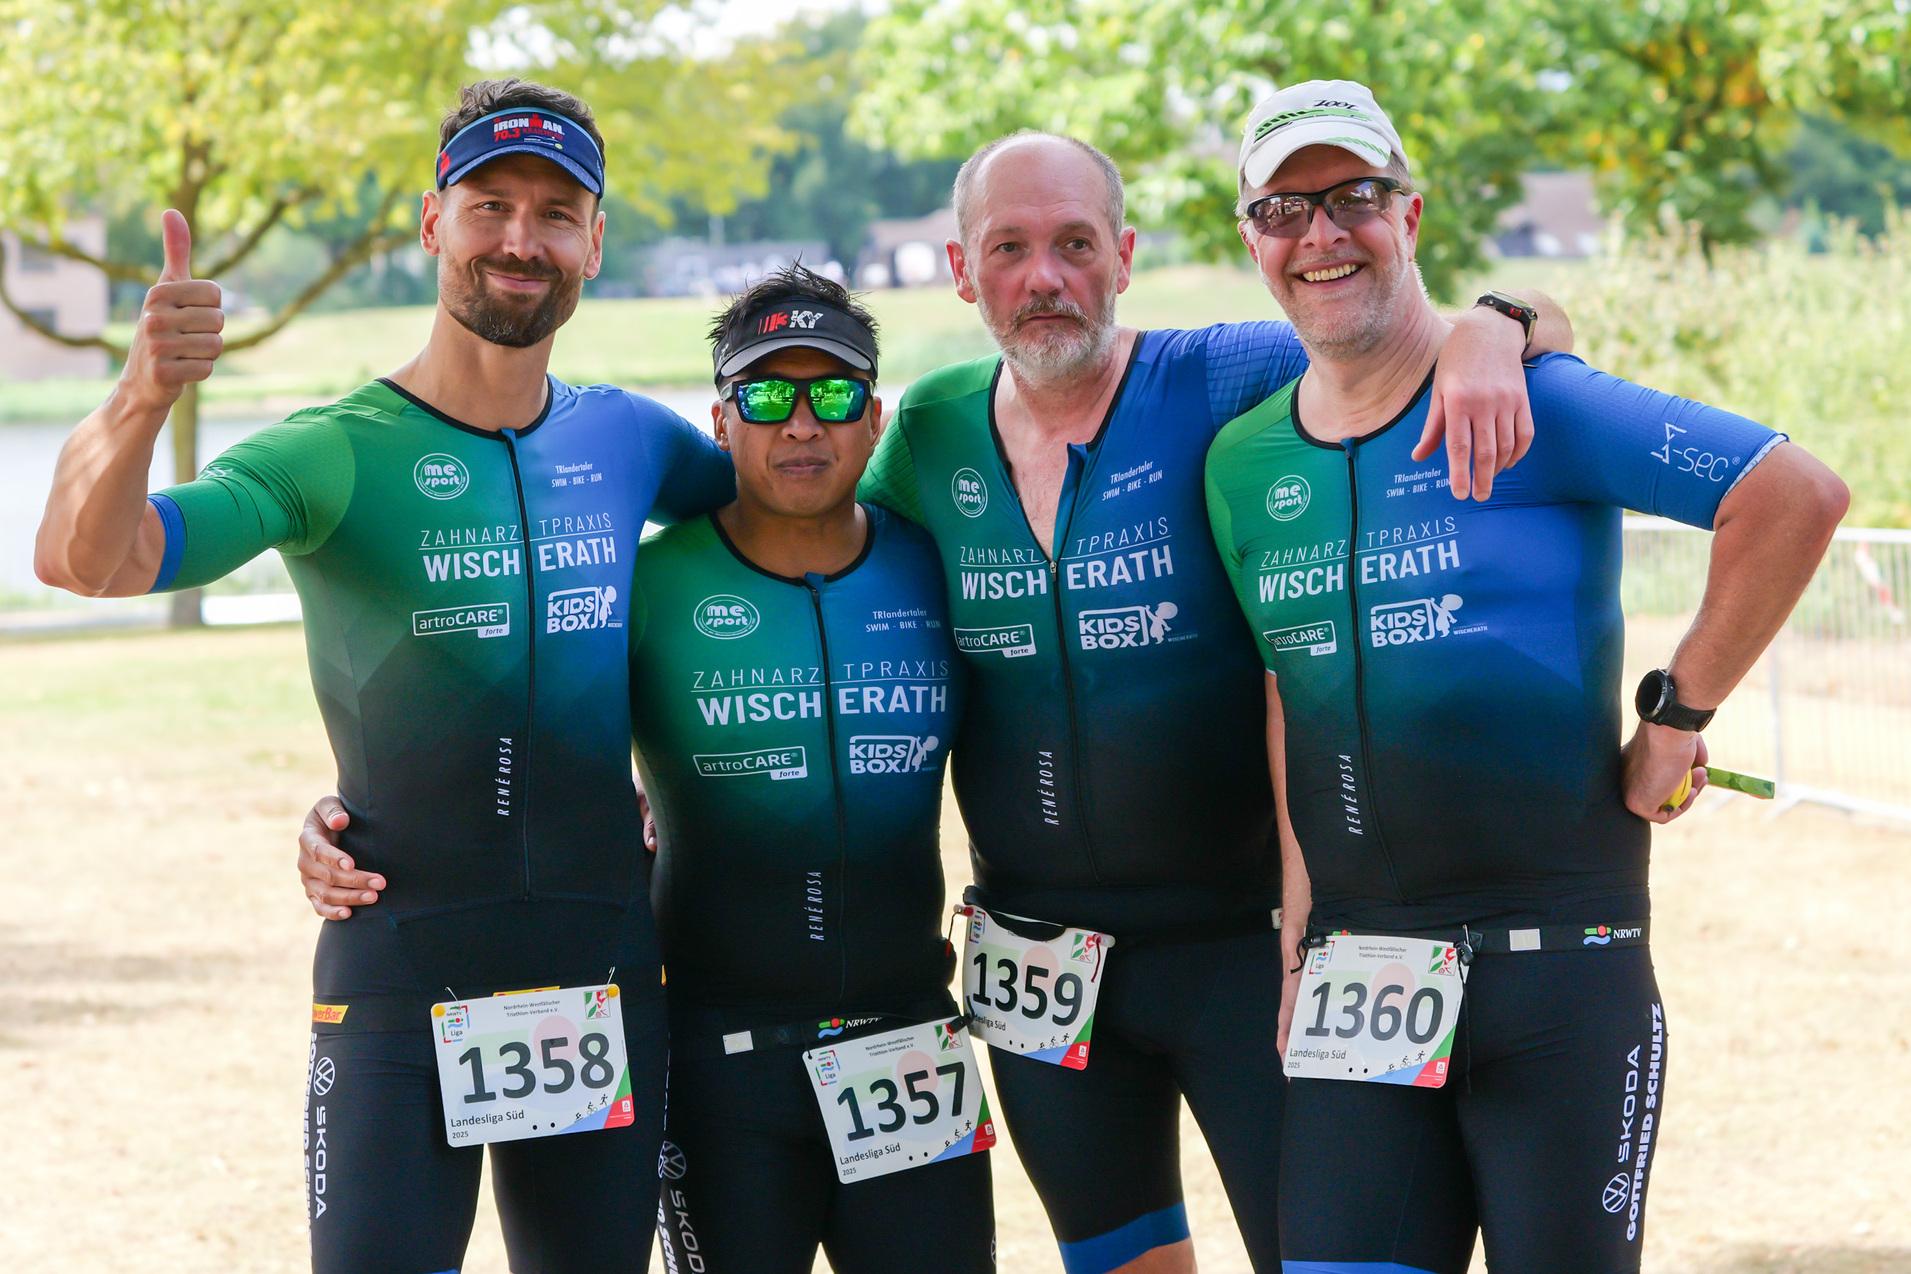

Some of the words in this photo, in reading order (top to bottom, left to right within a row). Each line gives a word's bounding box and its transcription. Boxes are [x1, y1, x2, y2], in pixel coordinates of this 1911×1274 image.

[495, 128, 520, 142] 70.3
[425, 475, 460, 488] sport
[551, 477, 567, 488] SWIM
[572, 474, 585, 485] BIKE
[591, 473, 603, 482] RUN
[958, 478, 980, 493] me
[1102, 487, 1120, 501] SWIM
[1127, 479, 1142, 493] BIKE
[1149, 470, 1163, 484] RUN
[959, 491, 983, 504] sport
[1275, 484, 1301, 499] me
[1386, 487, 1405, 498] SWIM
[1412, 483, 1428, 494] BIKE
[1274, 496, 1302, 510] sport
[420, 525, 518, 547] ZAHNARZ
[538, 512, 612, 536] TPRAXIS
[960, 546, 1040, 564] ZAHNARZ
[1077, 516, 1169, 555] TPRAXIS
[1261, 539, 1347, 567] ZAHNARZ
[1366, 516, 1457, 548] TPRAXIS
[423, 549, 520, 582] WISCH
[538, 536, 617, 572] ERATH
[961, 569, 1048, 600] WISCH
[1066, 544, 1174, 590] ERATH
[1258, 564, 1344, 603] WISCH
[1361, 540, 1461, 584] ERATH
[547, 596, 595, 617] KIDS
[707, 605, 745, 617] me
[547, 612, 593, 634] BOX
[706, 616, 748, 627] sport
[865, 621, 889, 633] SWIM
[899, 620, 918, 630] BIKE
[1079, 615, 1141, 635] KIDS
[1371, 608, 1427, 631] KIDS
[485, 627, 504, 636] forte
[1372, 626, 1427, 648] BOX
[1081, 632, 1141, 650] BOX
[1315, 645, 1331, 654] forte
[1010, 647, 1029, 656] forte
[693, 667, 820, 689] ZAHNARZ
[843, 660, 950, 680] TPRAXIS
[697, 691, 822, 726] WISCH
[838, 685, 947, 715] ERATH
[850, 743, 909, 759] KIDS
[779, 768, 801, 778] forte
[850, 759, 903, 775] BOX
[1613, 927, 1642, 939] NRWTV
[973, 952, 1083, 1027] 1359
[1305, 981, 1444, 1045] 1360
[1289, 1048, 1330, 1060] Landesliga
[1331, 1049, 1347, 1060] Süd
[459, 1032, 615, 1104] 1358
[837, 1061, 965, 1142] 1357
[450, 1113, 504, 1128] Landesliga
[505, 1109, 525, 1121] Süd
[1625, 1113, 1653, 1241] GOTTFRIED
[1646, 1002, 1663, 1107] SCHULTZ
[452, 1131, 469, 1139] 2025
[839, 1148, 884, 1166] Landesliga
[885, 1142, 901, 1155] Süd
[842, 1167, 857, 1176] 2025
